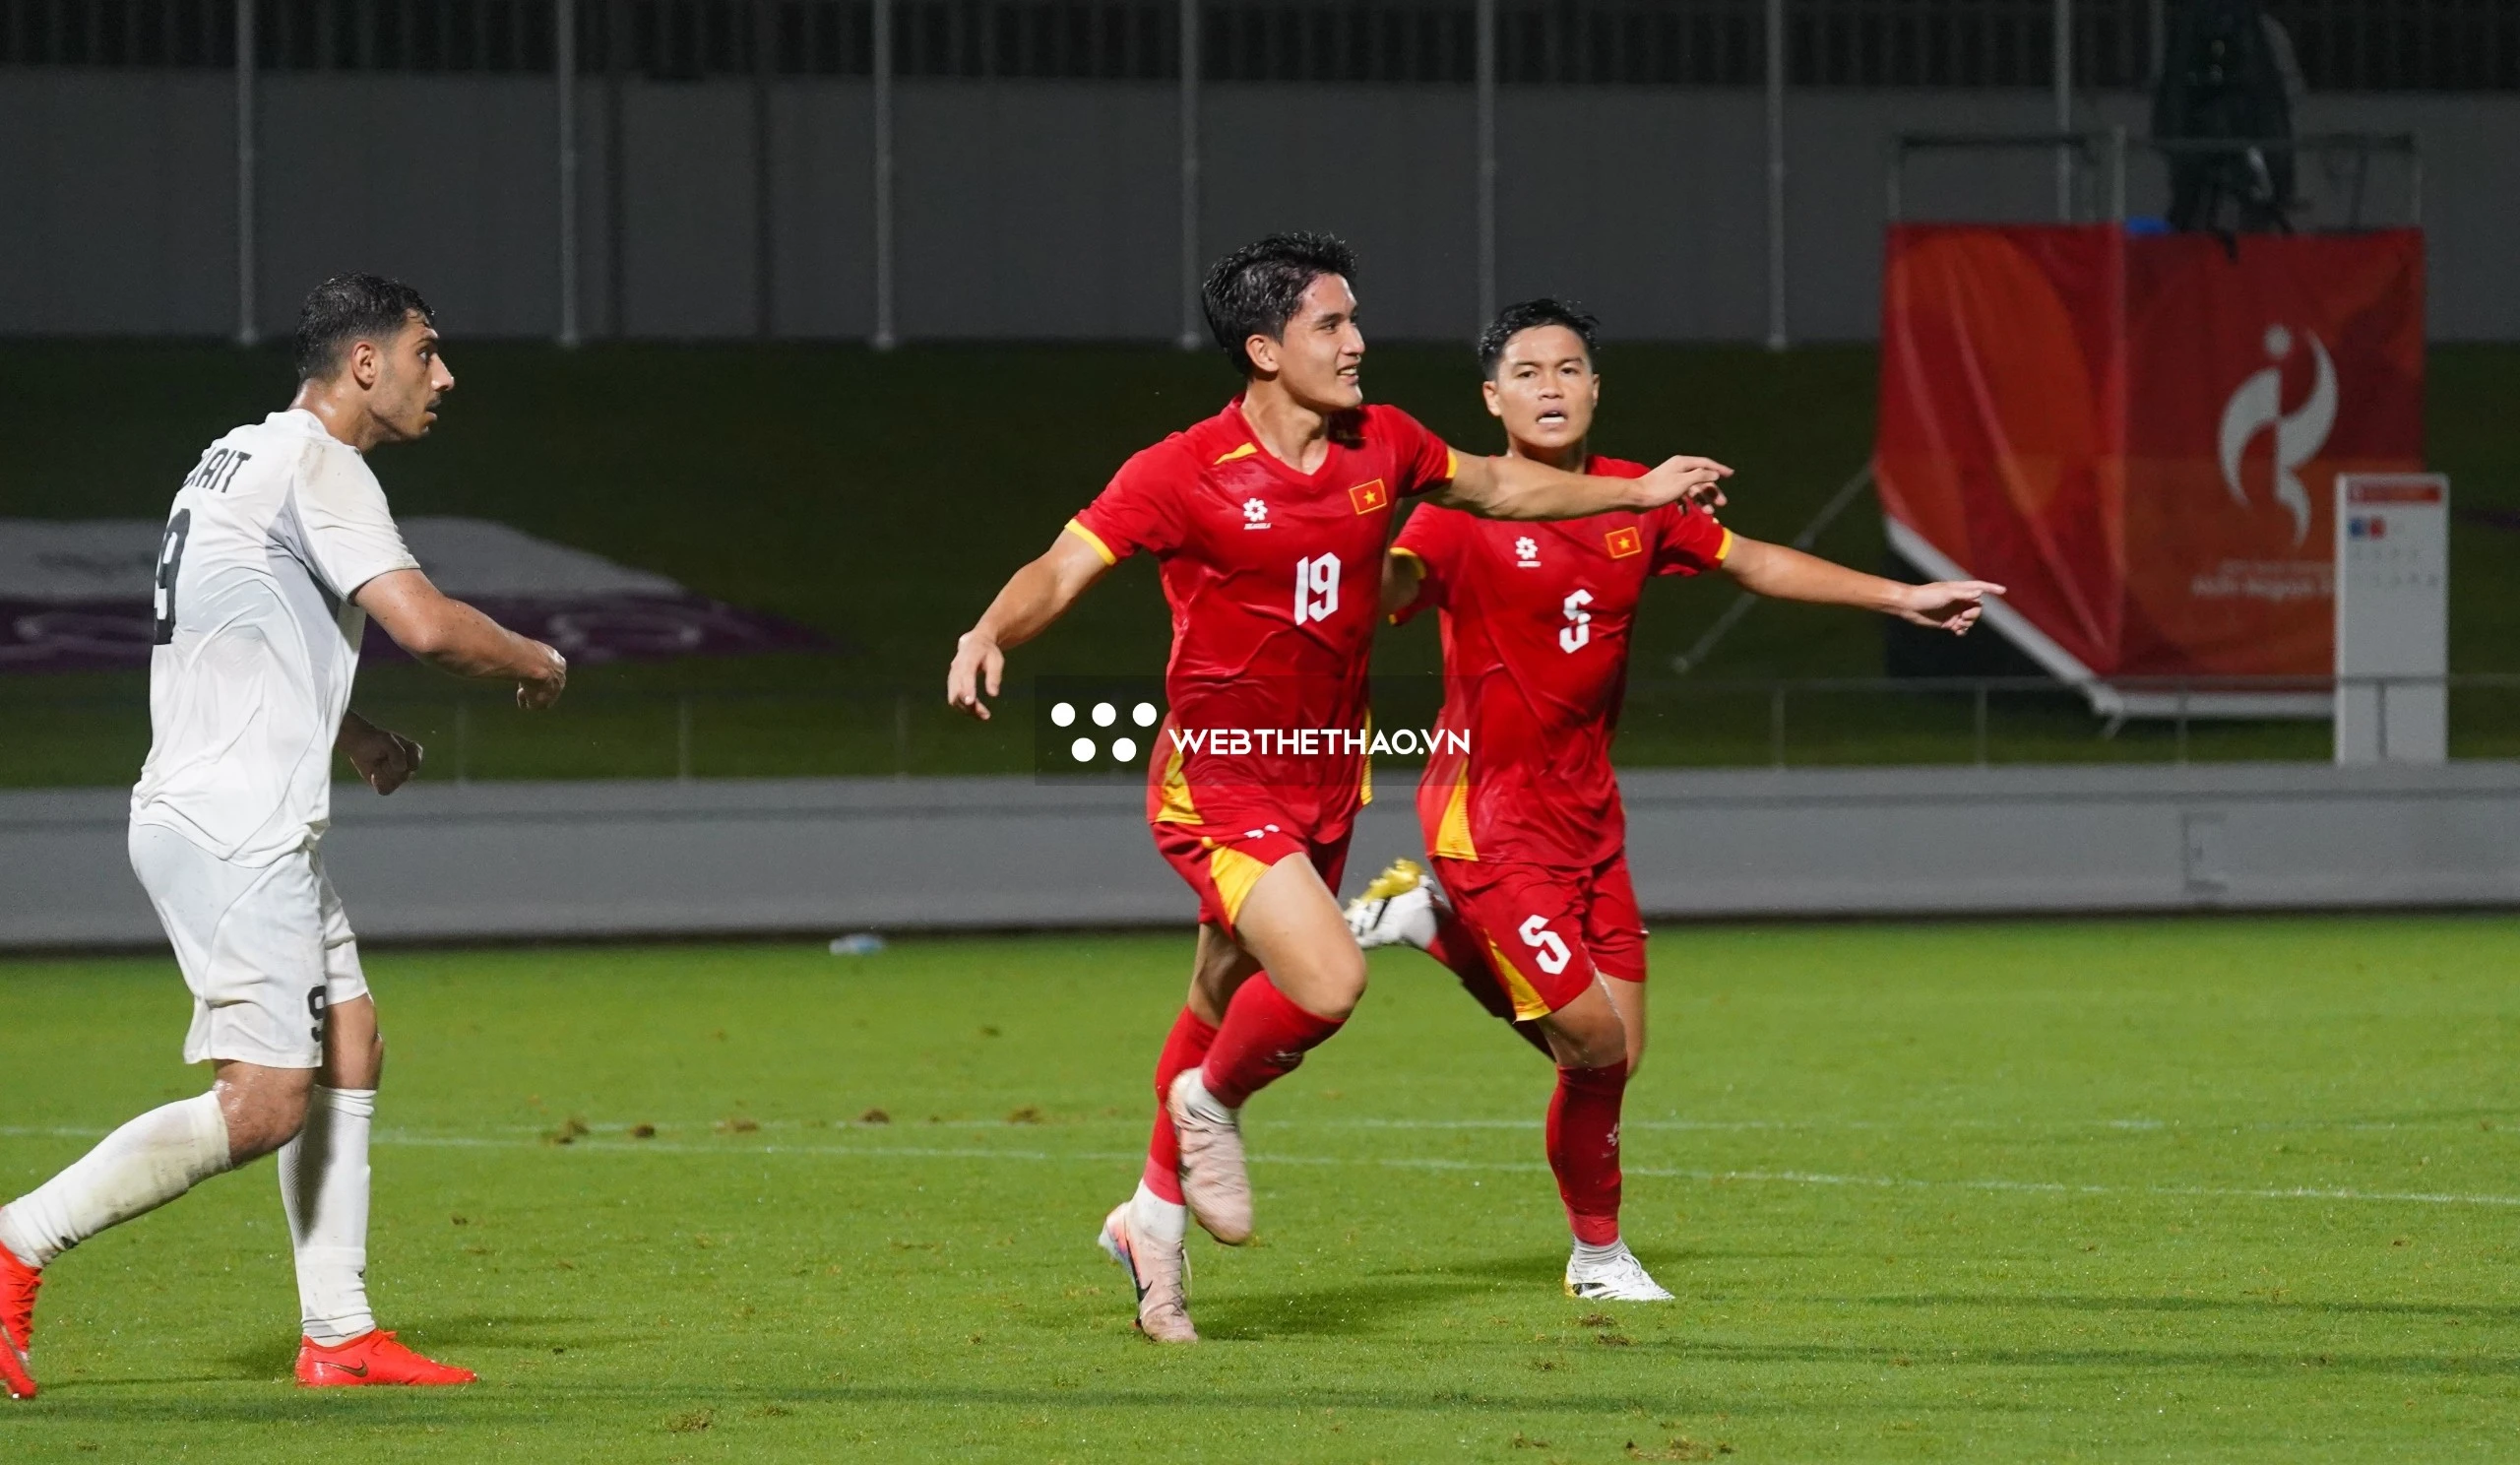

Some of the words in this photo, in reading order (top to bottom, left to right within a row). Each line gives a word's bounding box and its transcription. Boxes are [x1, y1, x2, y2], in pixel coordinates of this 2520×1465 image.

[1294, 551, 1341, 626] 19
[1559, 589, 1594, 654] 5
[1518, 914, 1572, 975] 5
